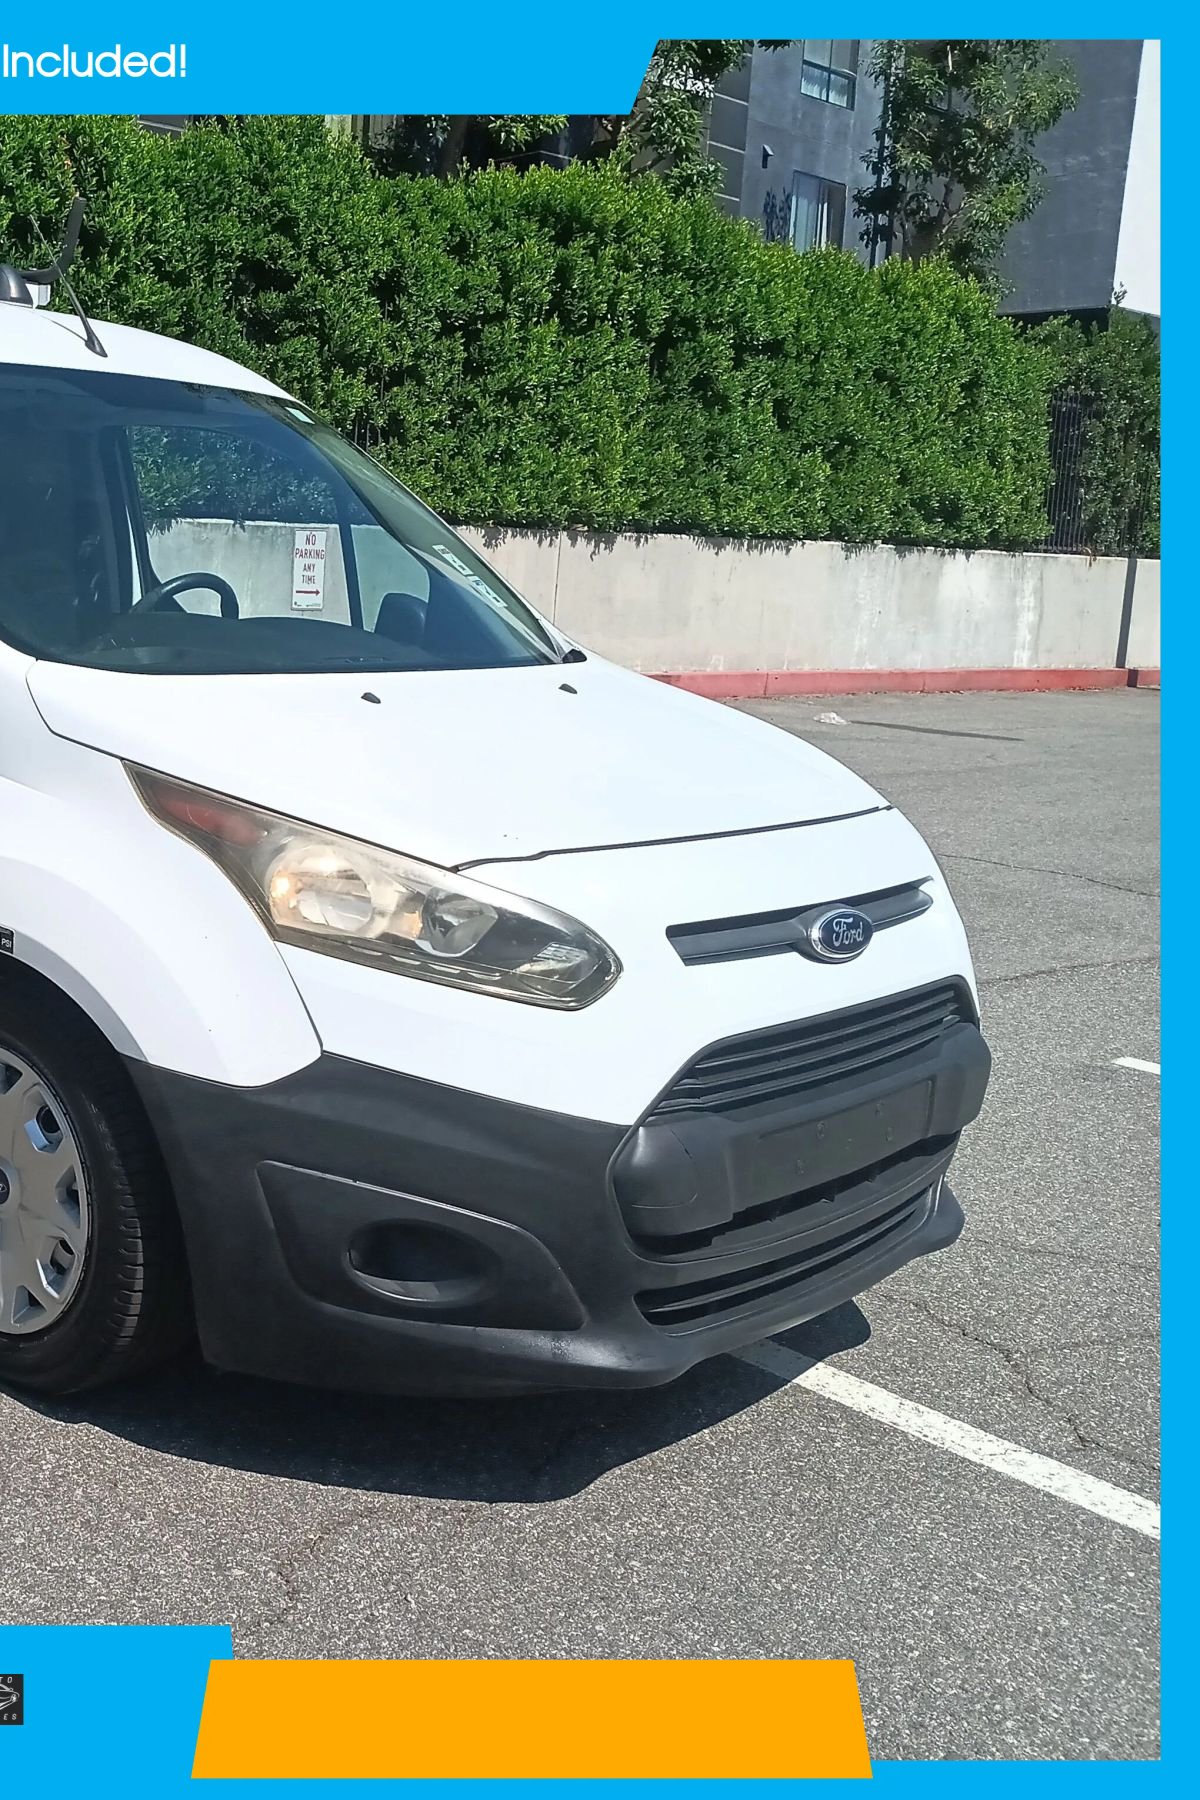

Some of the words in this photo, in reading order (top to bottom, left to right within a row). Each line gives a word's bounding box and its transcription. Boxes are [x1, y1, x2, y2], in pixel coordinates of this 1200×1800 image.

[305, 533, 317, 546] NO
[294, 547, 325, 560] PARKING
[302, 563, 316, 573] ANY
[301, 574, 316, 585] TIME
[832, 917, 865, 947] Ford
